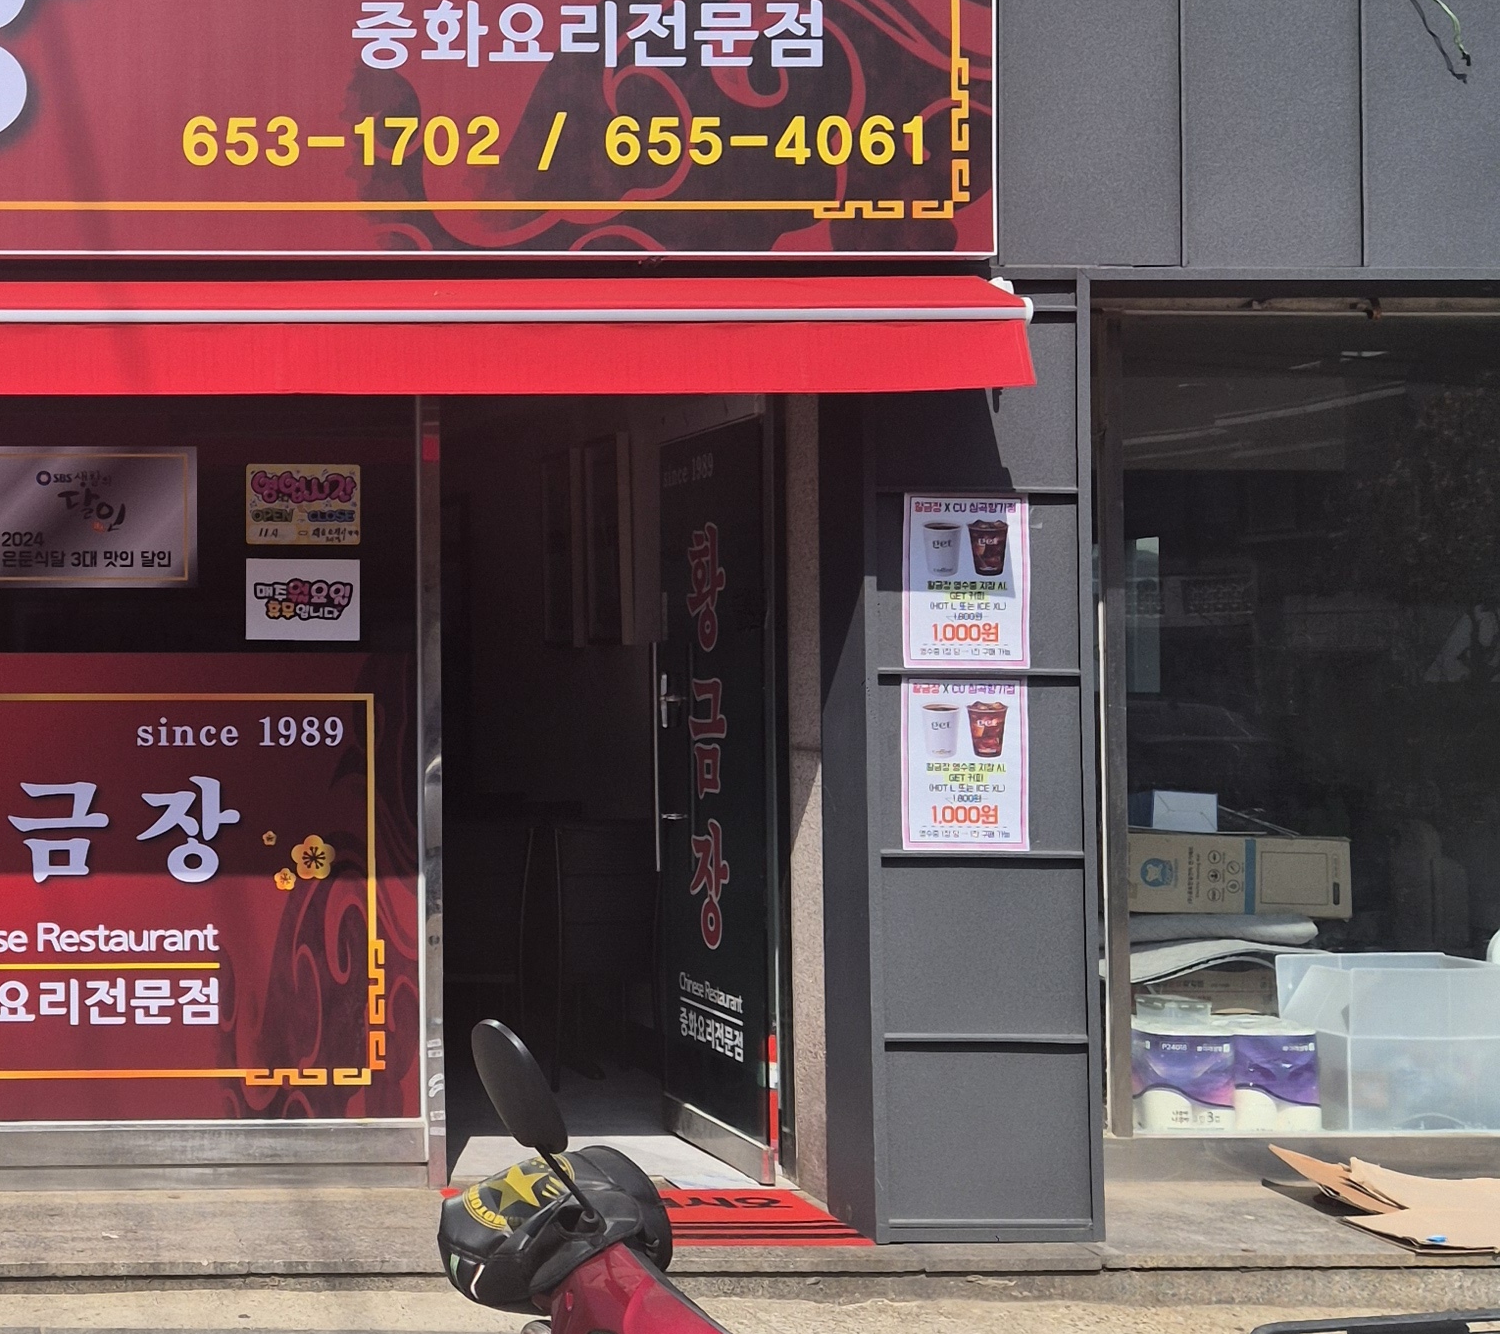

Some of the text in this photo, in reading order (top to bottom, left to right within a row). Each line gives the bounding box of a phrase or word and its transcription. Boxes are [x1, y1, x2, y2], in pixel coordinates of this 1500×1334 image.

[352, 0, 825, 70] 중화요리전문점
[181, 115, 502, 168] 653-1702
[604, 115, 927, 167] 655-4061
[53, 473, 73, 483] SBS
[690, 451, 714, 482] 1989
[250, 470, 357, 504] 영업시간
[57, 488, 127, 532] 달인
[251, 508, 356, 523] OPEN CLOSE
[944, 502, 951, 512] X
[953, 502, 968, 512] CU
[1, 531, 44, 547] 2024
[2, 550, 172, 568] 은둔식달 3대 맛의 달인
[255, 578, 353, 607] 매주 월요일
[949, 592, 966, 600] GET
[266, 600, 340, 620] 휴무입니다
[943, 684, 949, 694] X
[136, 716, 345, 749] since 1989
[686, 522, 730, 951] 황금장
[948, 774, 965, 782] GET
[36, 921, 220, 954] Restaurant
[679, 971, 743, 1014] Chinese Restaurant
[678, 1006, 744, 1063] 중화요리전문점
